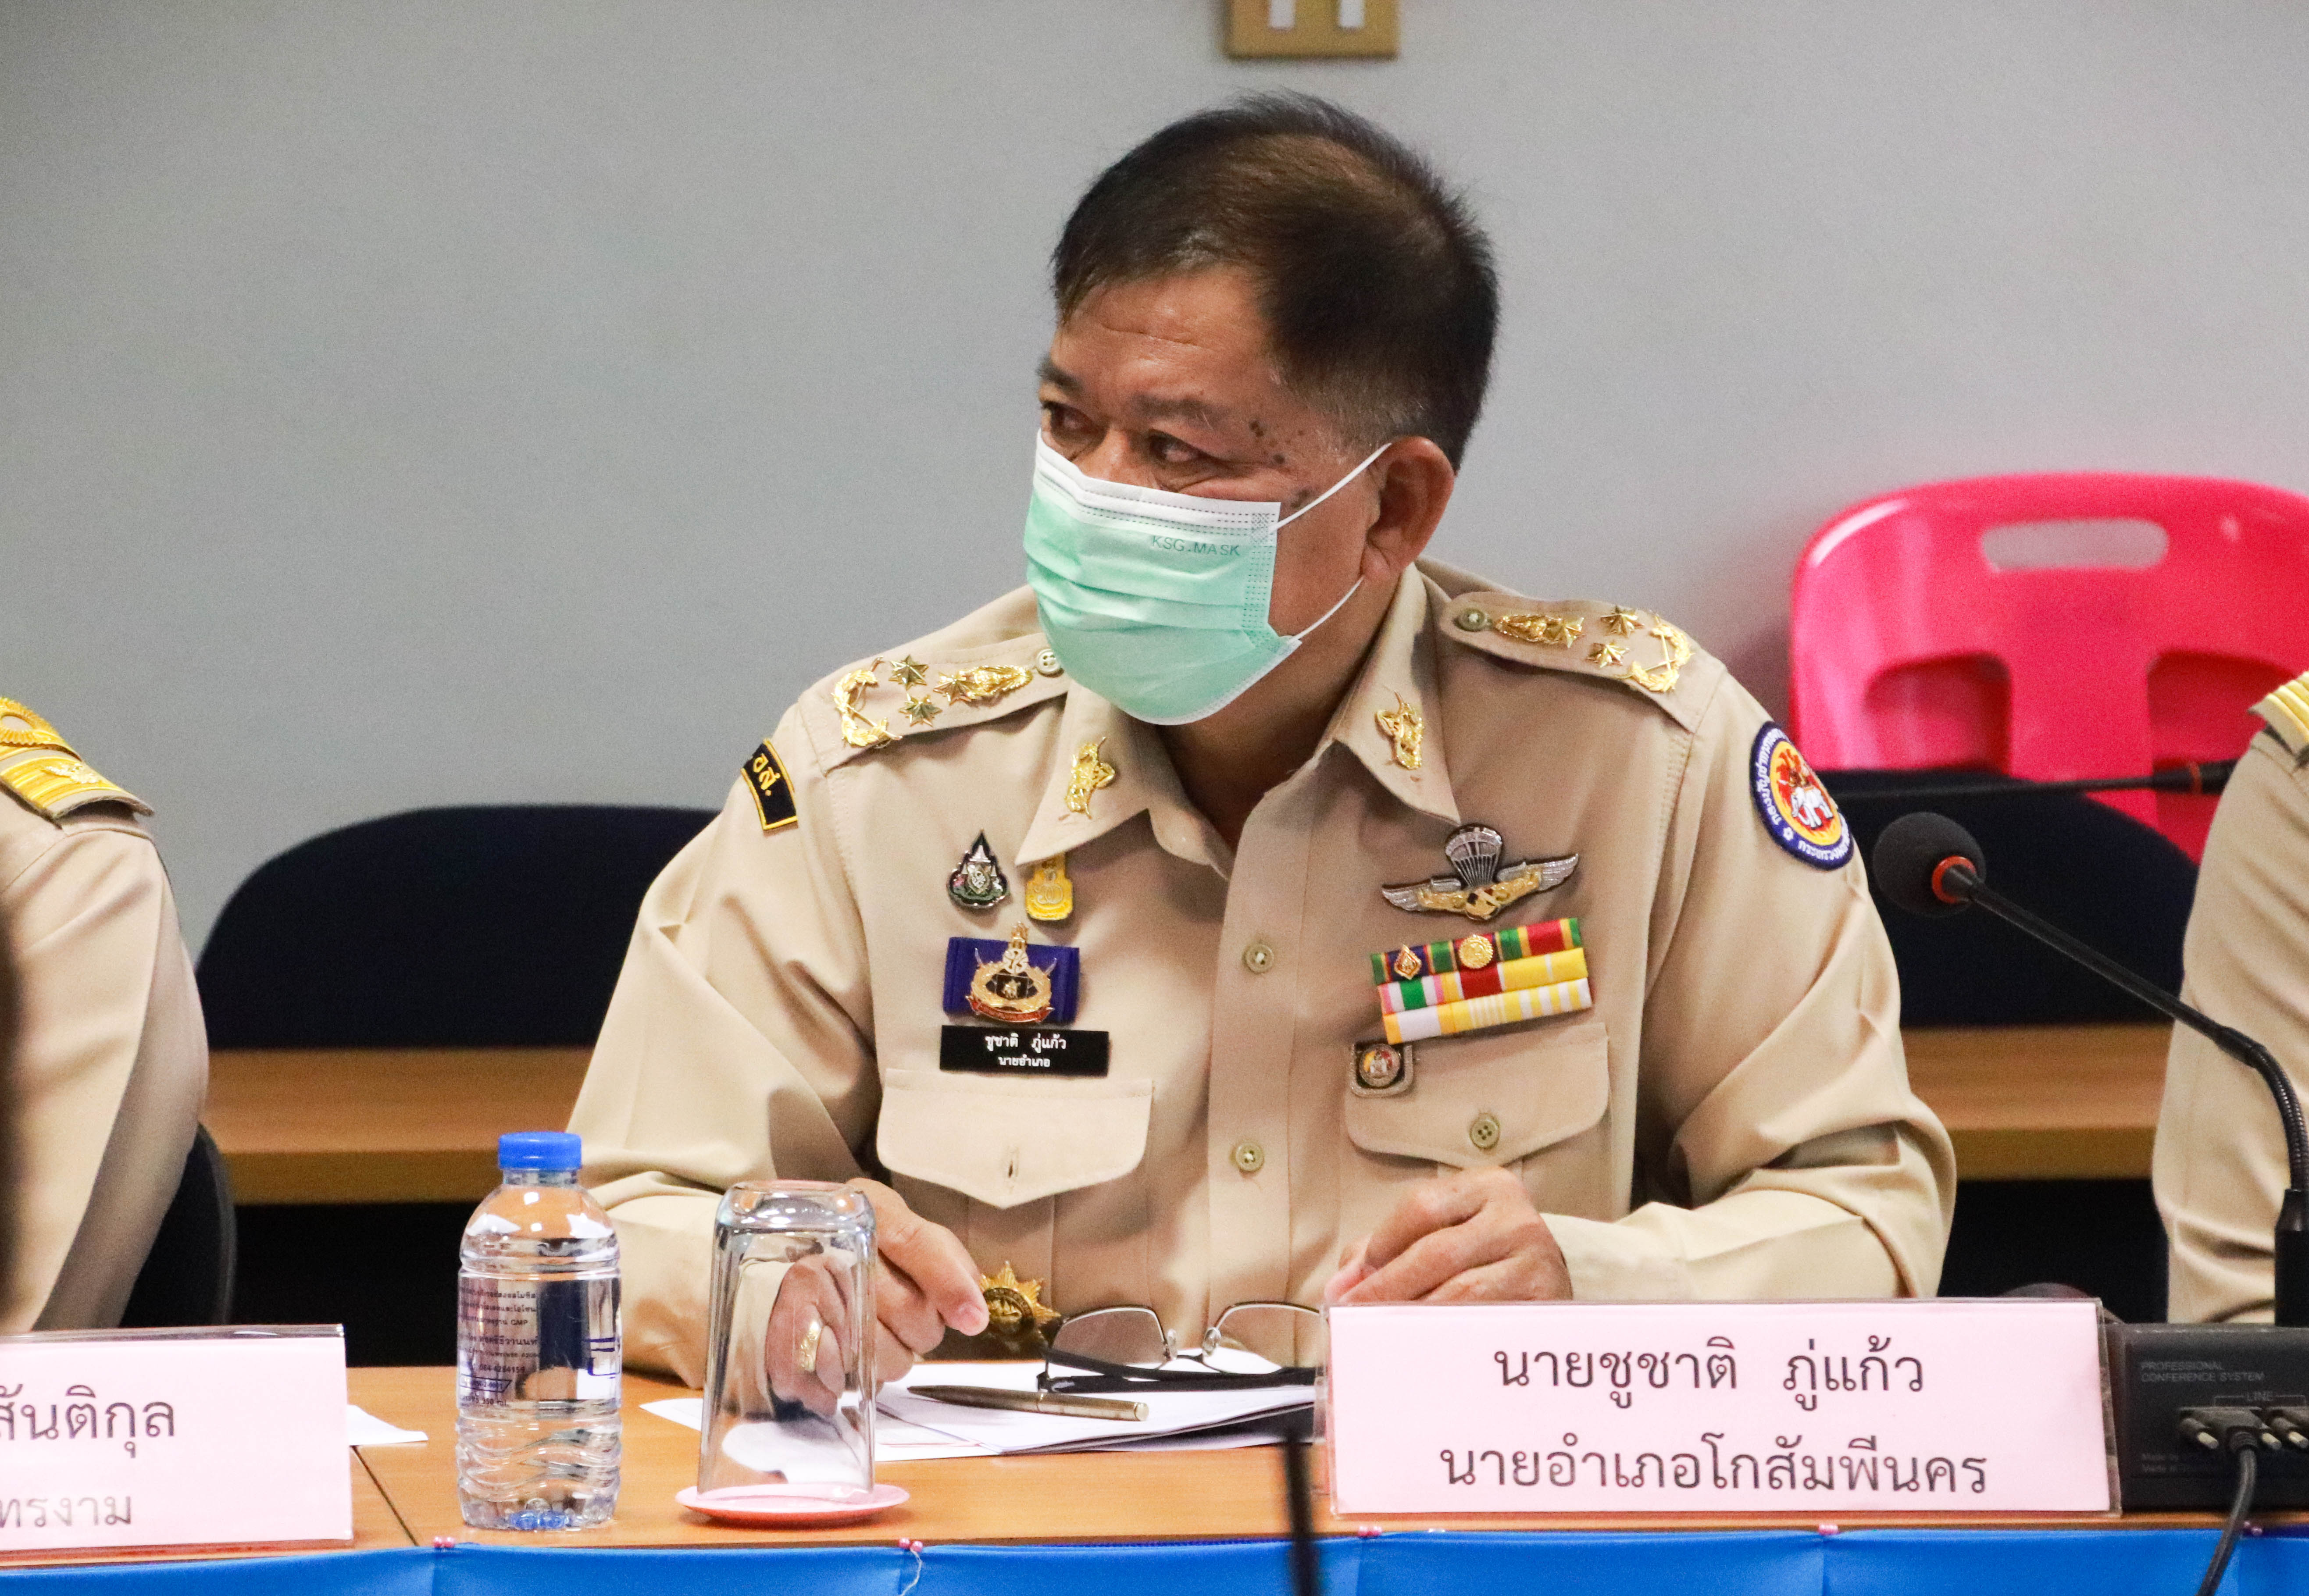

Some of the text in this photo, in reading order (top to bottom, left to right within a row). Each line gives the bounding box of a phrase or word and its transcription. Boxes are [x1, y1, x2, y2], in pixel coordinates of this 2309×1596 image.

[985, 1032, 1067, 1054] ชูชาติ ภู่แก้ว
[998, 1053, 1051, 1068] นายอำเภอ
[1494, 1335, 1924, 1411] นายชูชาติ ภู่แก้ว
[2141, 1361, 2223, 1370] PROFESSIONAL
[2141, 1371, 2265, 1382] CONFERENCE SYSTEM
[1440, 1432, 1987, 1494] นายอำเภอโกสัมพีนคร
